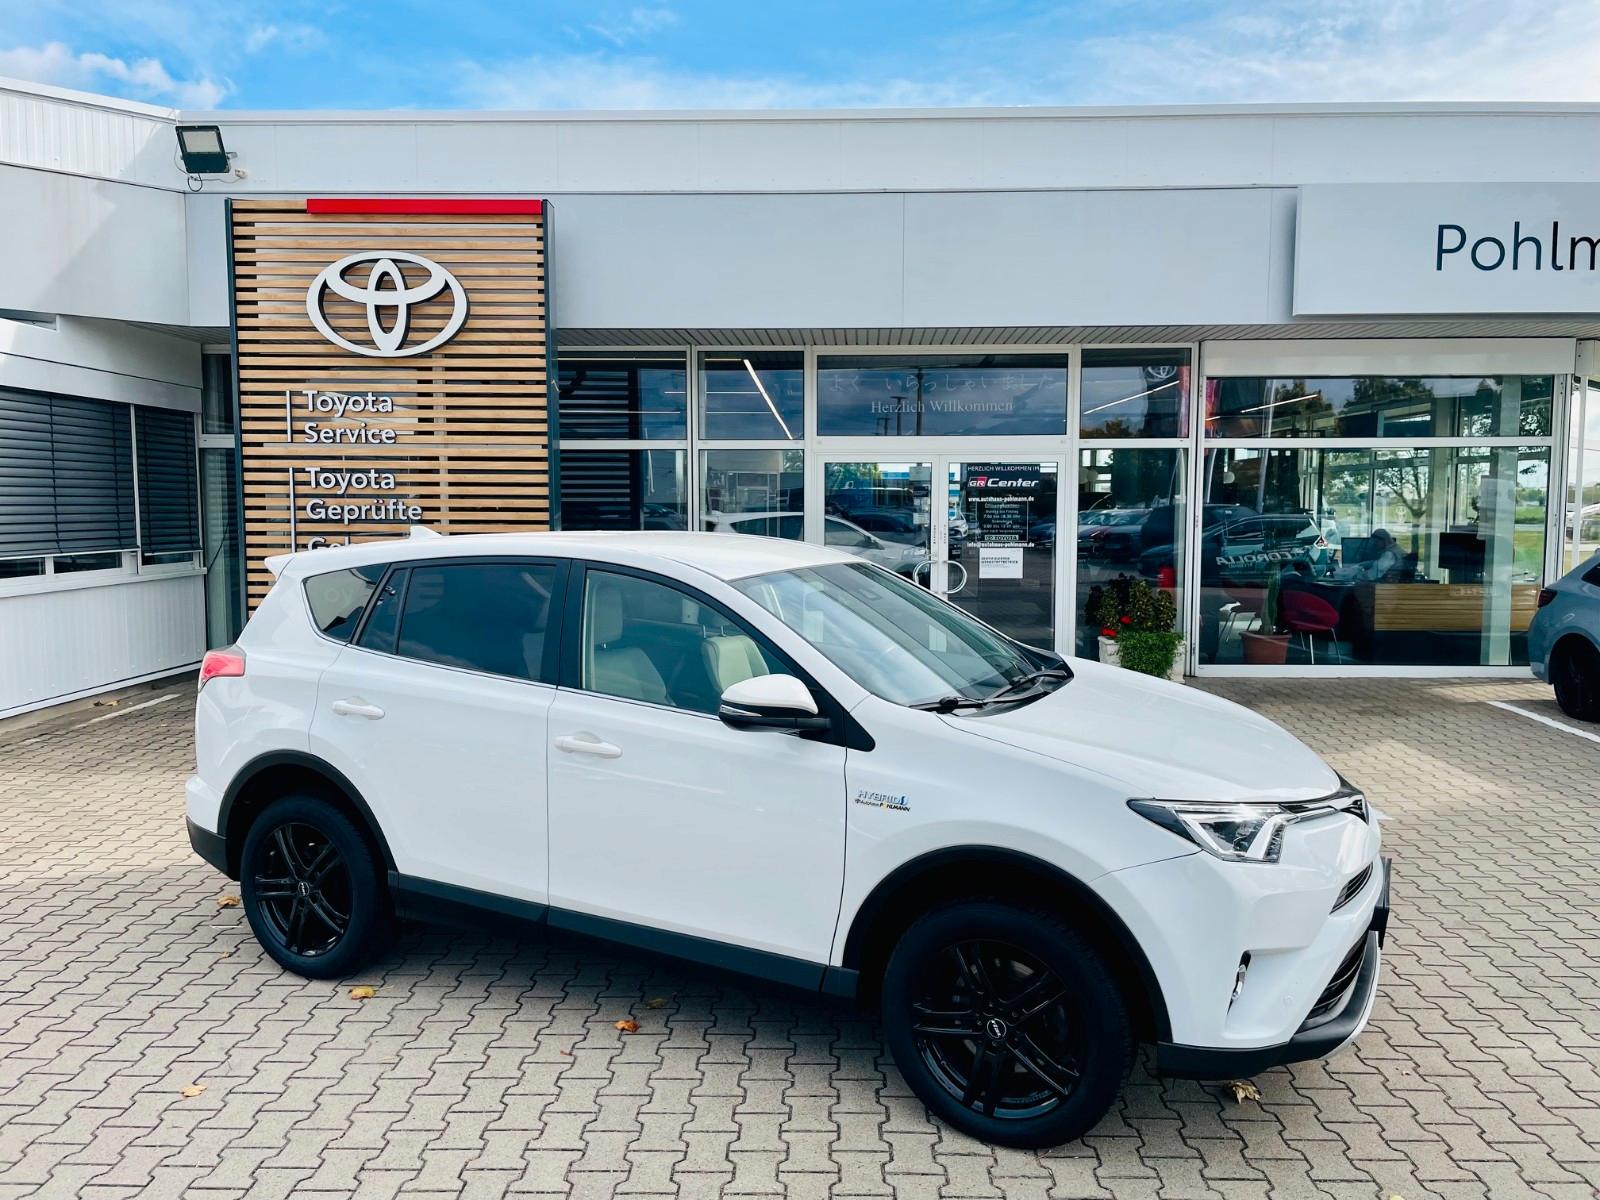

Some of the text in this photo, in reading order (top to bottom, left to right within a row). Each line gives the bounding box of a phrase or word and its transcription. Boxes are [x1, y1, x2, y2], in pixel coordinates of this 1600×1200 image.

[302, 390, 393, 417] Toyota
[871, 399, 1014, 413] Herzlich Willkommen
[304, 423, 396, 443] Service
[305, 467, 395, 494] Toyota
[968, 477, 1039, 488] GR Center
[306, 499, 423, 525] Geprüfte
